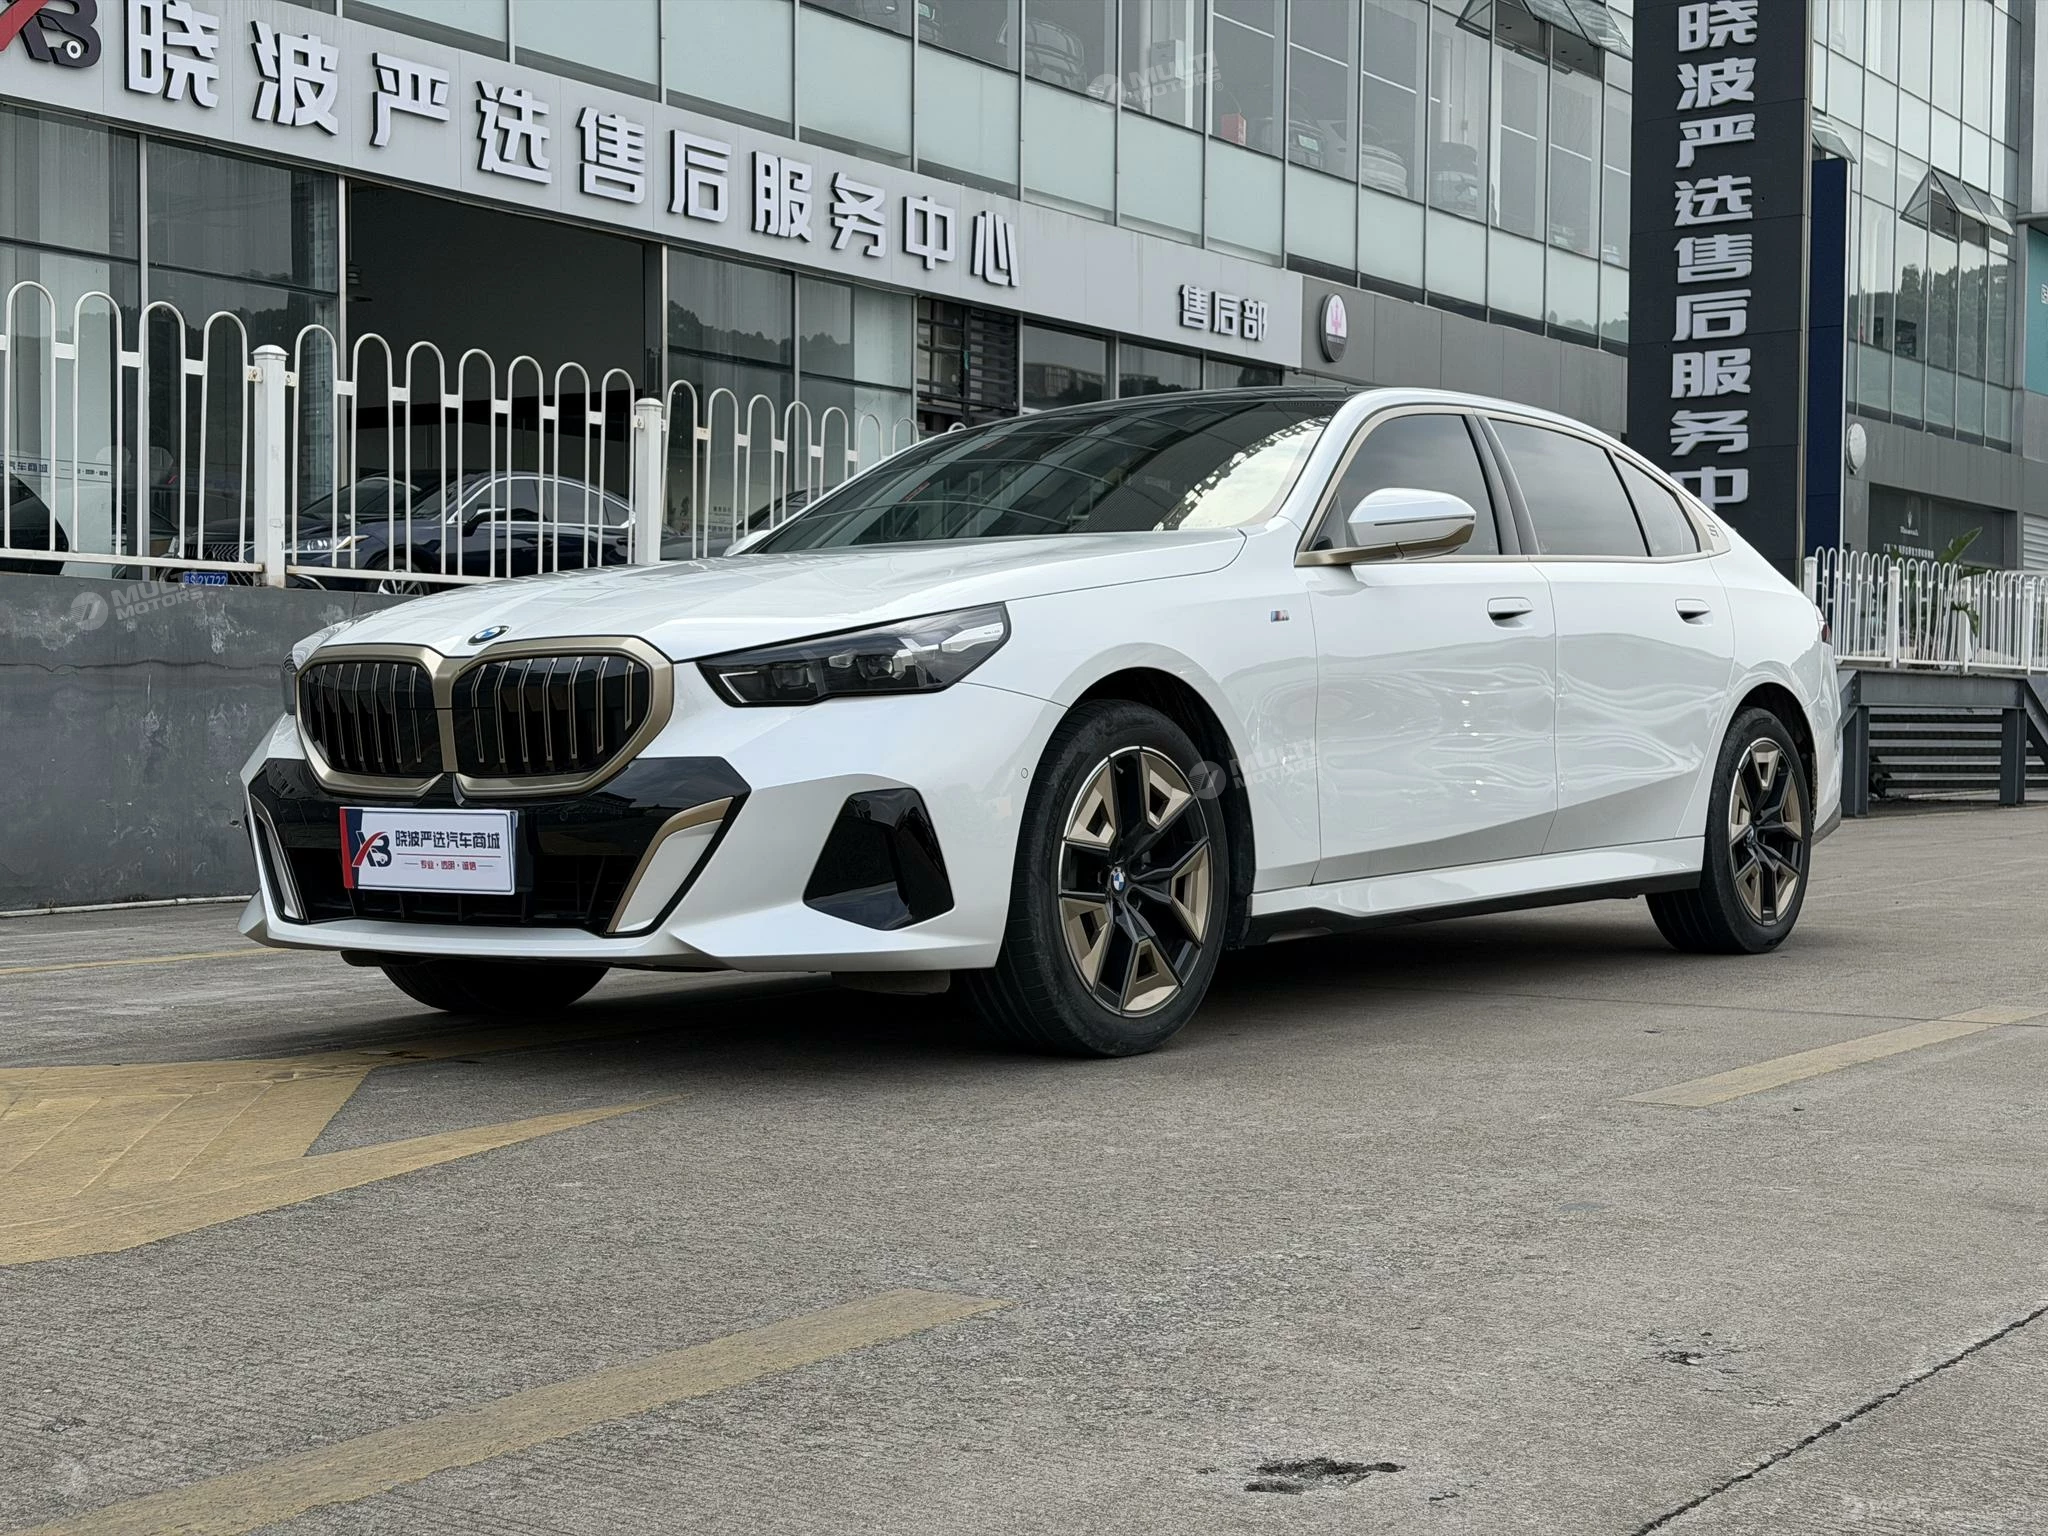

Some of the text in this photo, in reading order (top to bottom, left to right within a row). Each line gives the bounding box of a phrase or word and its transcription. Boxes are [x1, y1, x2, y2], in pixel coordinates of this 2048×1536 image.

[124, 0, 1020, 287] 晓波严选售后服务中心
[1179, 284, 1268, 342] 售后部
[395, 830, 500, 849] 晓波严选汽车商城
